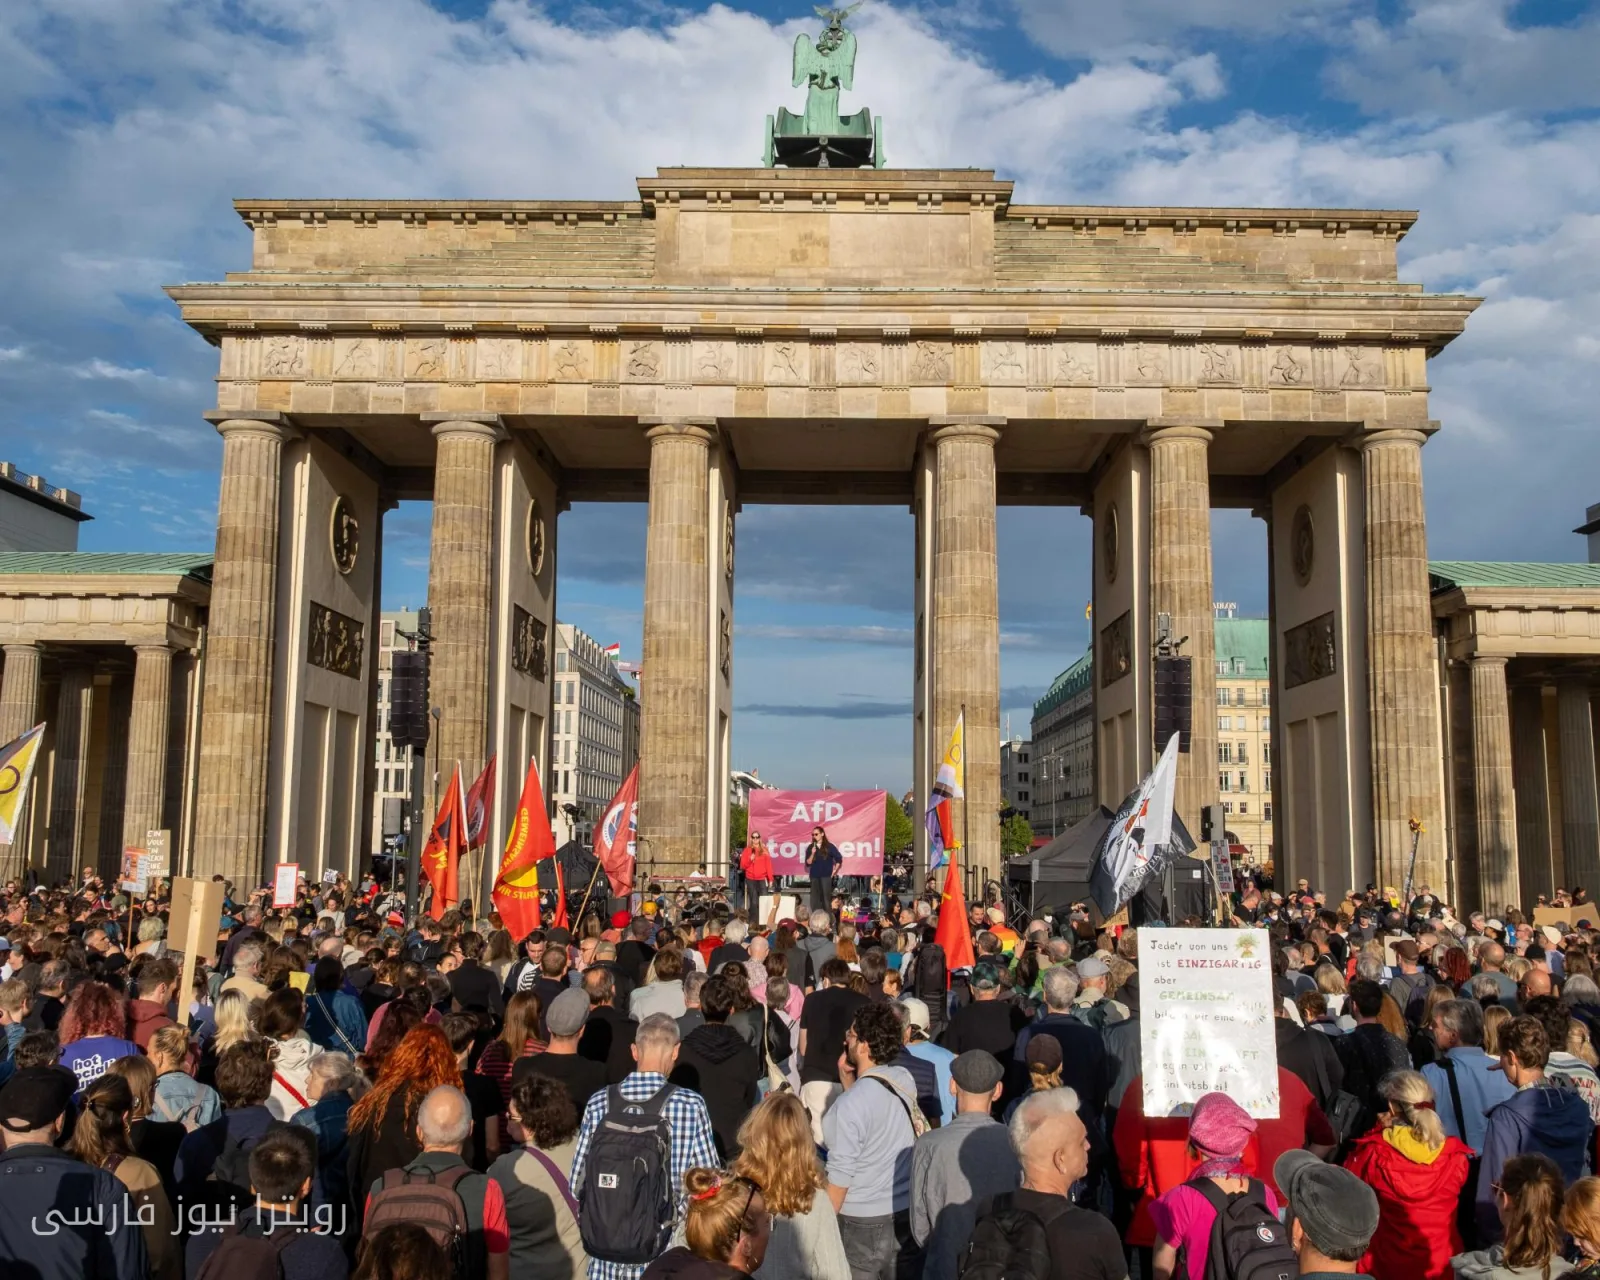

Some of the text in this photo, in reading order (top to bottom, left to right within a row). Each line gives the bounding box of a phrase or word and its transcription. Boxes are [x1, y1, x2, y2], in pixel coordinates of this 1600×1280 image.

[1212, 602, 1237, 610] ADLON
[790, 800, 844, 823] AfD
[766, 837, 881, 864] topen!
[1211, 943, 1228, 951] uns
[1157, 959, 1171, 968] ist
[1153, 975, 1177, 985] aber
[1214, 1013, 1235, 1022] eine
[74, 1055, 100, 1071] hot
